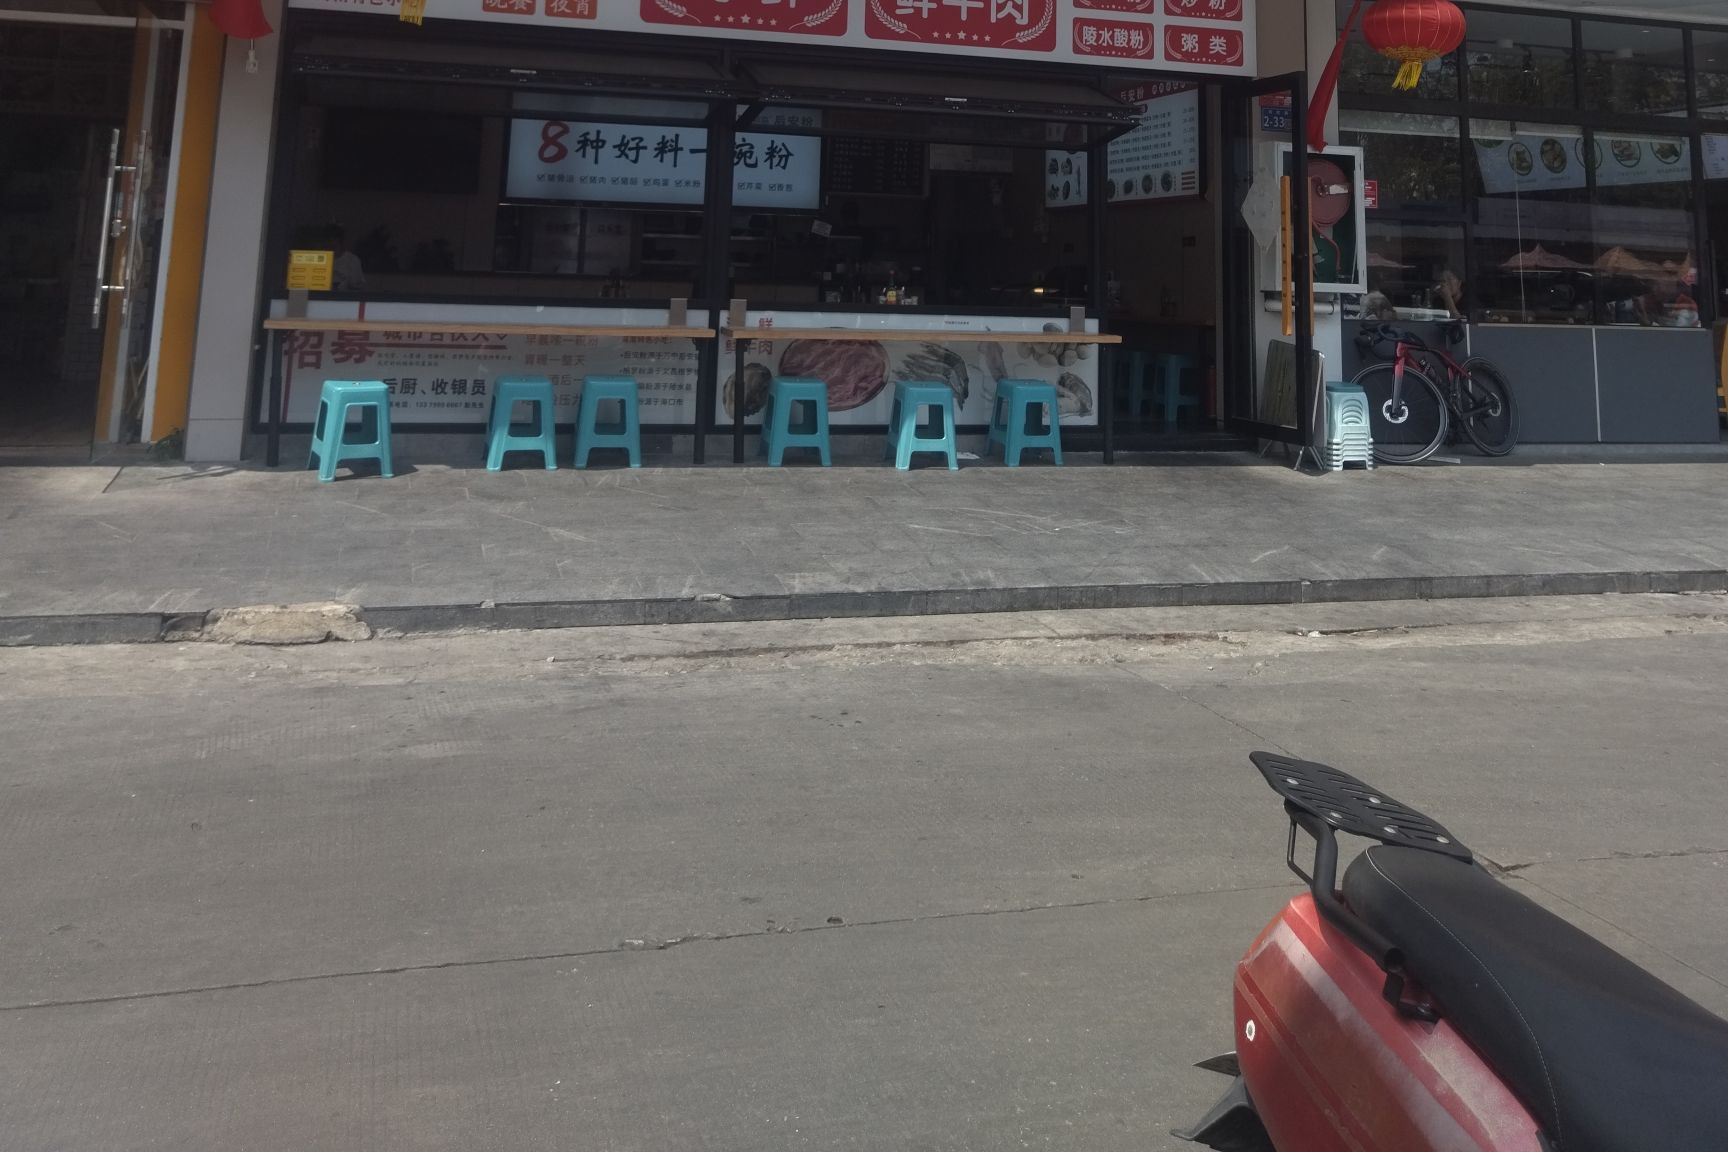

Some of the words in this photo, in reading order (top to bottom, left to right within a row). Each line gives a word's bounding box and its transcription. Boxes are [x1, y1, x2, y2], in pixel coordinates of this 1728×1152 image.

[1083, 26, 1144, 49] 陵水酸粉
[1181, 33, 1228, 56] 粥类
